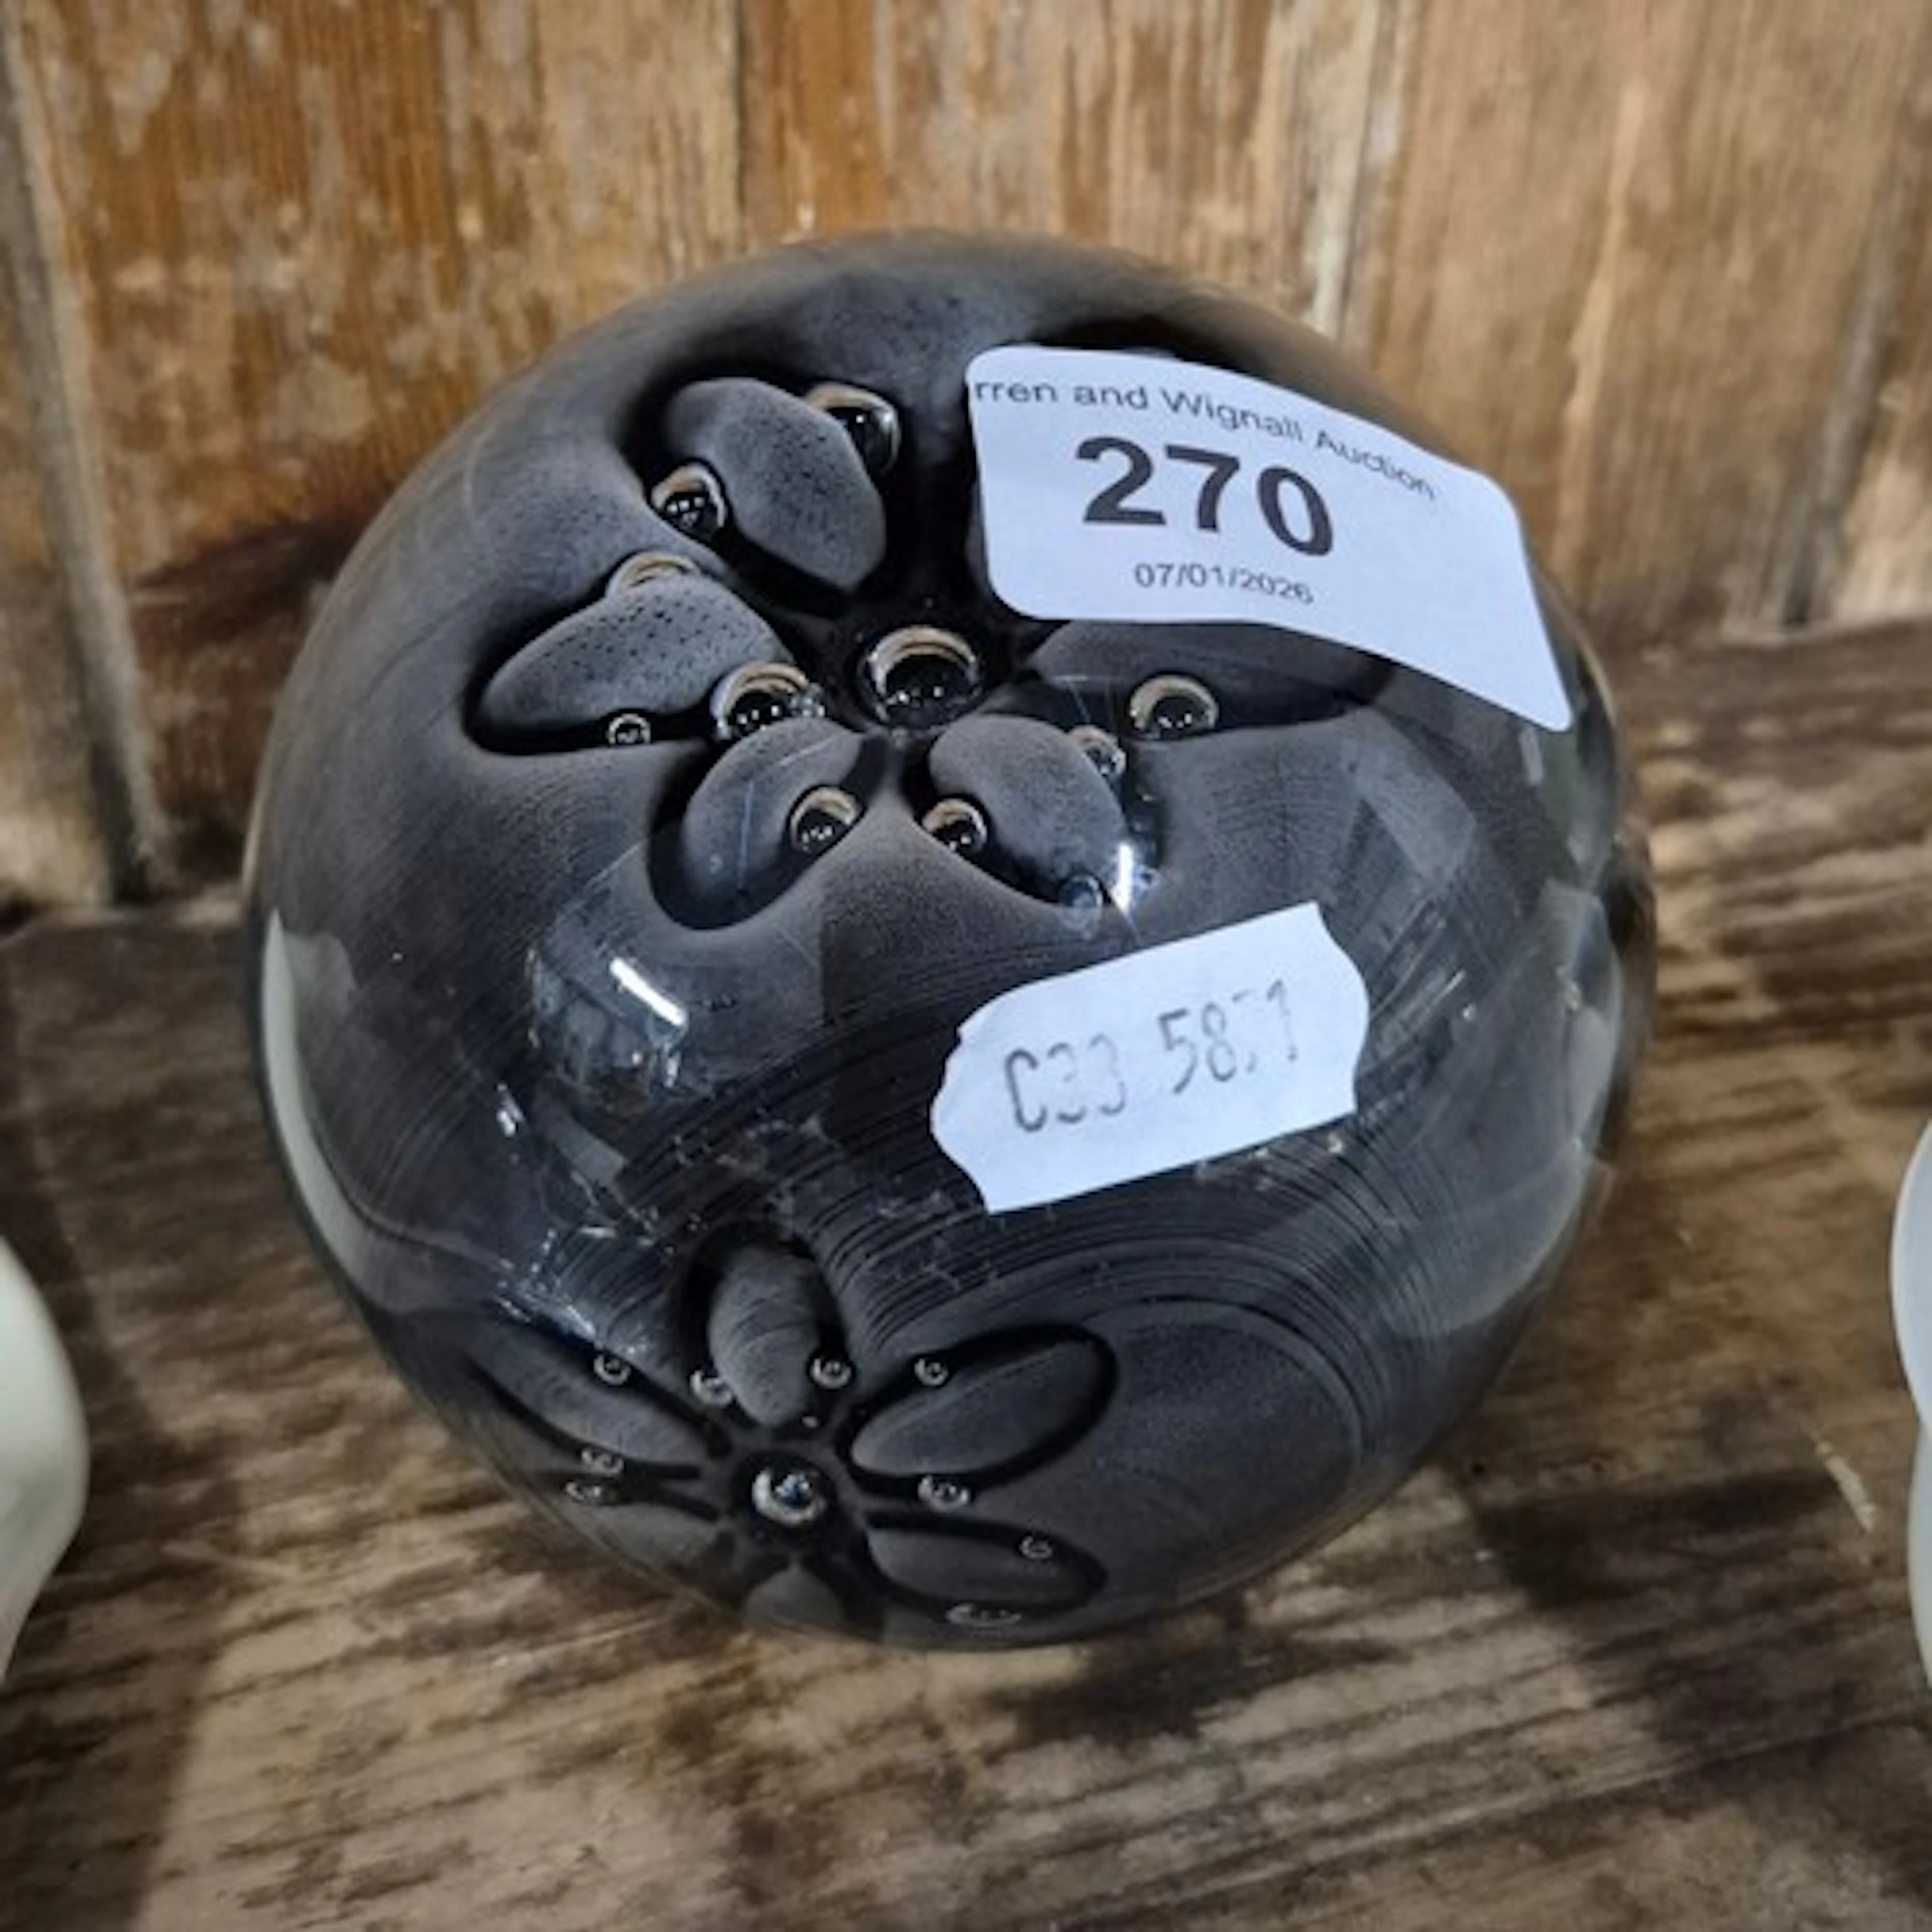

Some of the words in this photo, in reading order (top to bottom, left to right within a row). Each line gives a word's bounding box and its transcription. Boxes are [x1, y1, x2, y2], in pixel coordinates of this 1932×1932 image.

[1073, 384, 1149, 410] and
[1160, 386, 1304, 442] Wignall
[1315, 430, 1438, 502] Auction
[1076, 436, 1335, 557] 270
[1134, 562, 1314, 605] 07/01/2026
